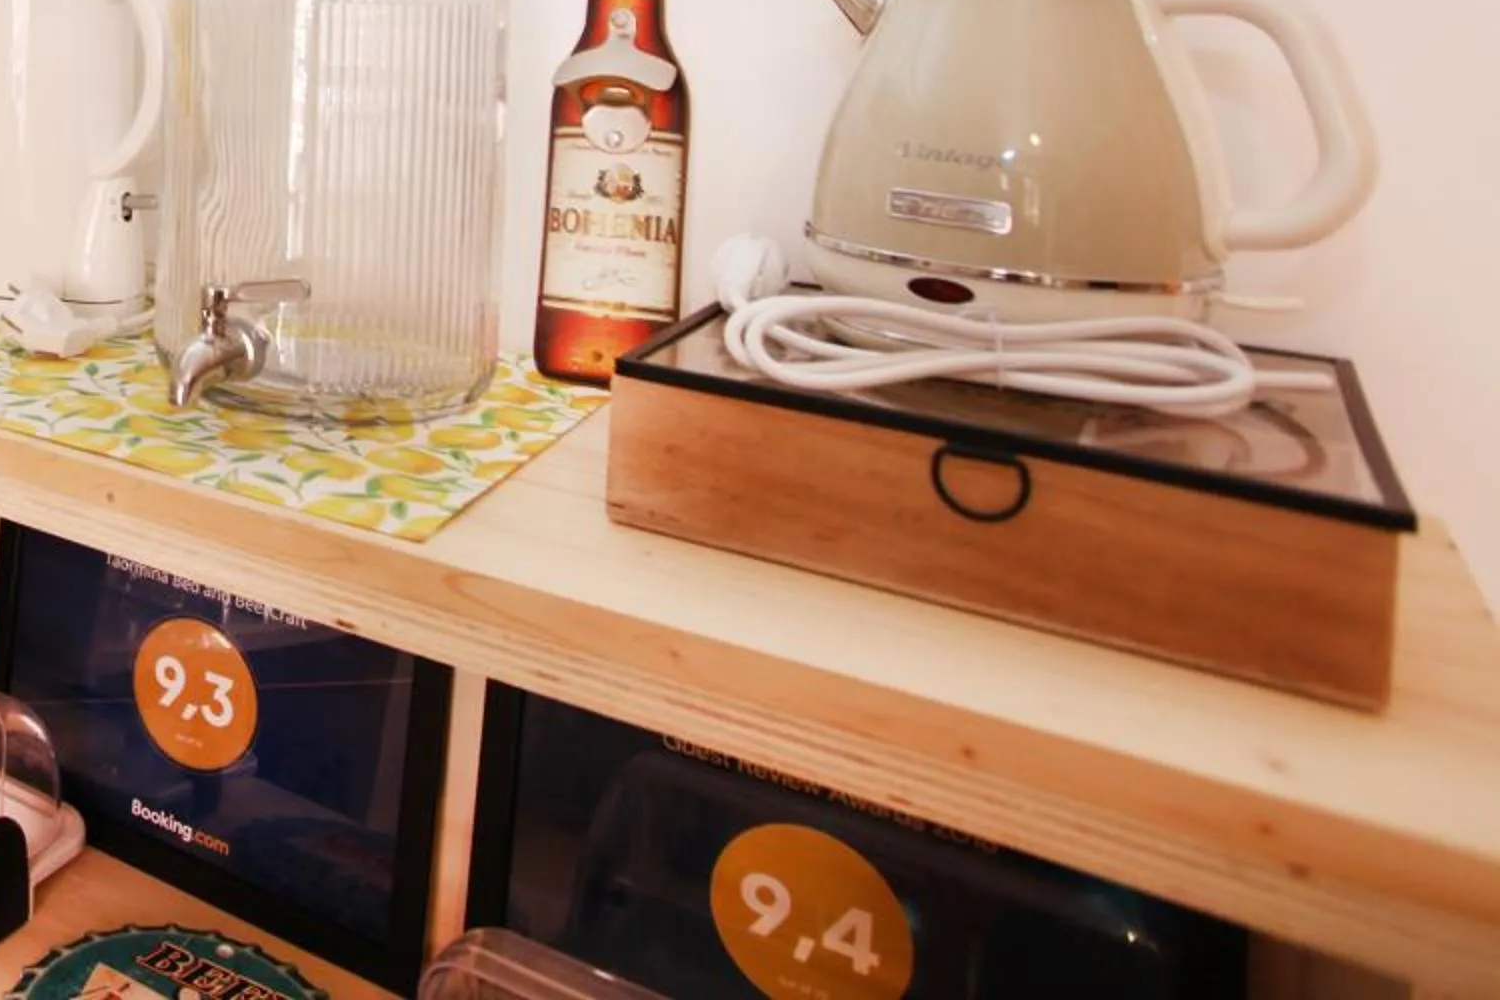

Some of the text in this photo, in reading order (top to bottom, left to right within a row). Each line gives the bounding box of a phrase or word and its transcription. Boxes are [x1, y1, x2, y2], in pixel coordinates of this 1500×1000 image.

[154, 655, 235, 728] 9,3
[131, 797, 229, 855] Booking.com
[740, 872, 882, 977] 9,4
